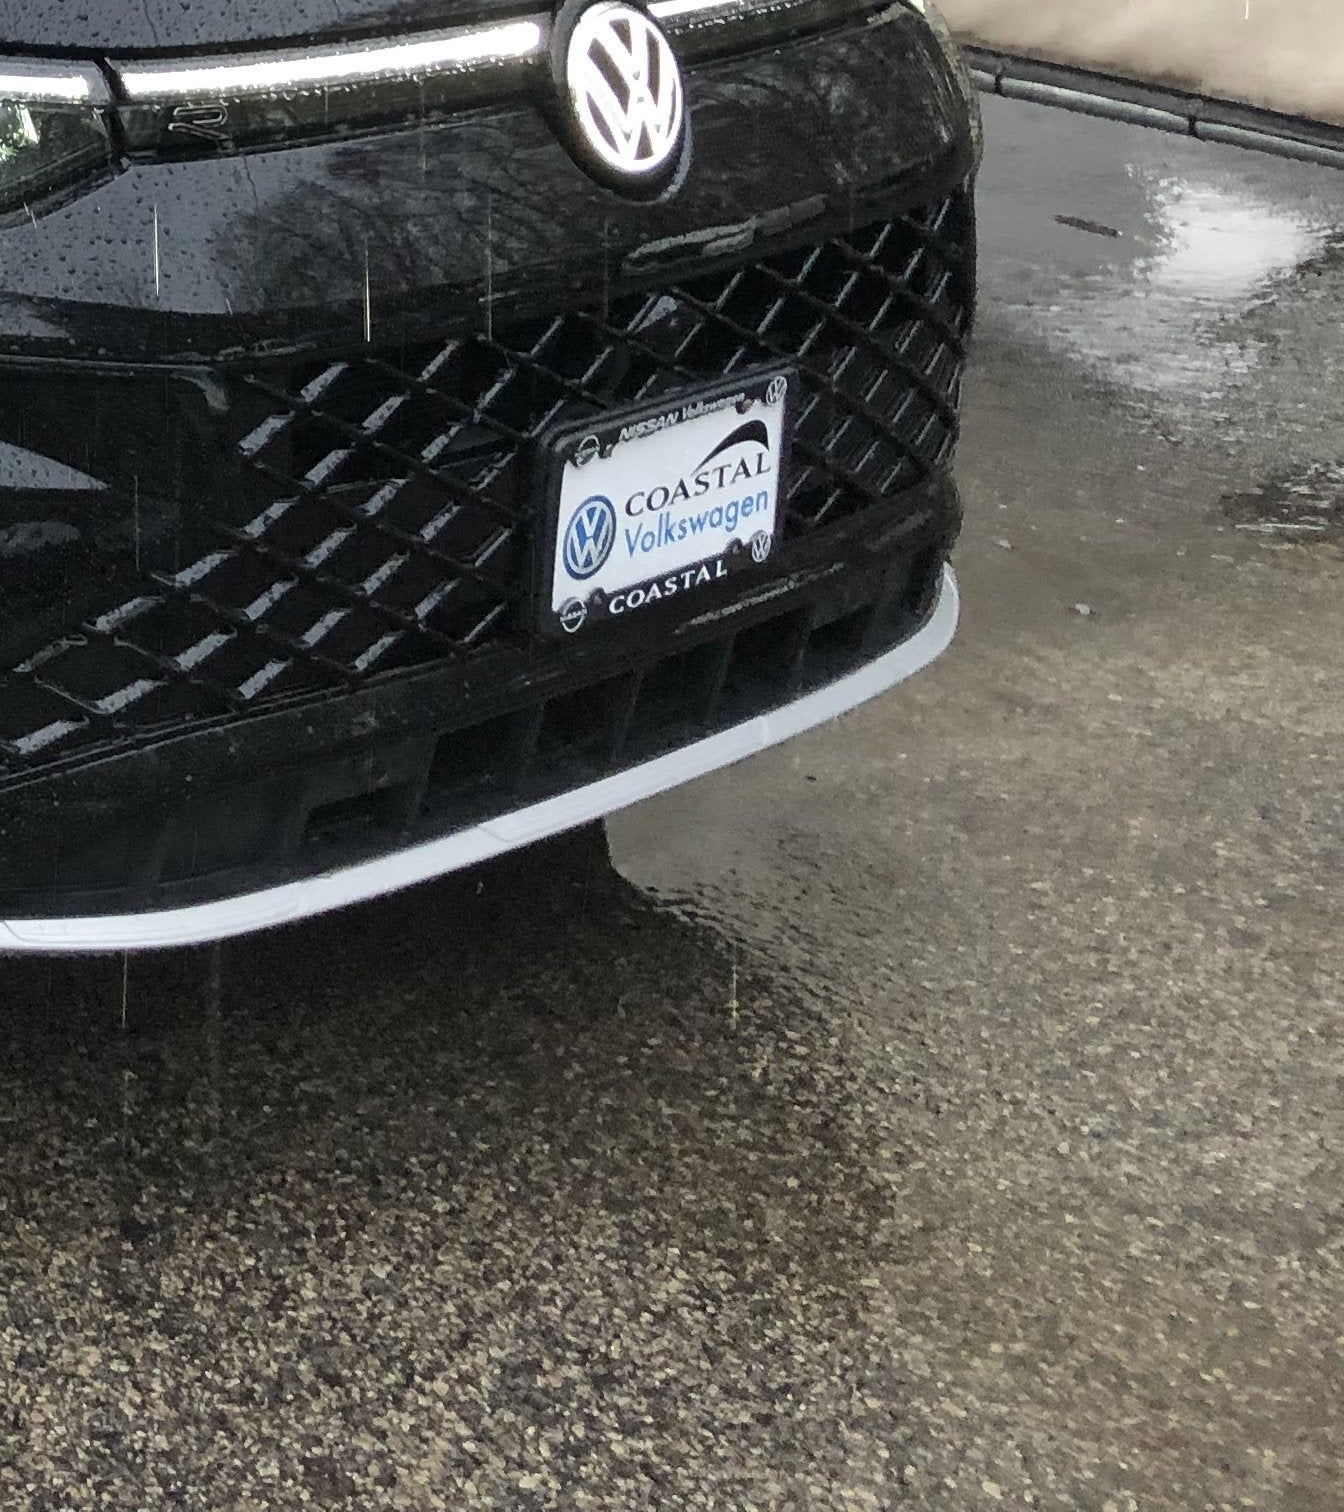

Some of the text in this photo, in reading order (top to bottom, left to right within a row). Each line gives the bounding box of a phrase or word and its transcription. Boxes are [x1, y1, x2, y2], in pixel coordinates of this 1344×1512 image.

[624, 451, 771, 517] COASTAL
[624, 490, 769, 557] Volkswagen
[609, 559, 728, 614] COASTAL
